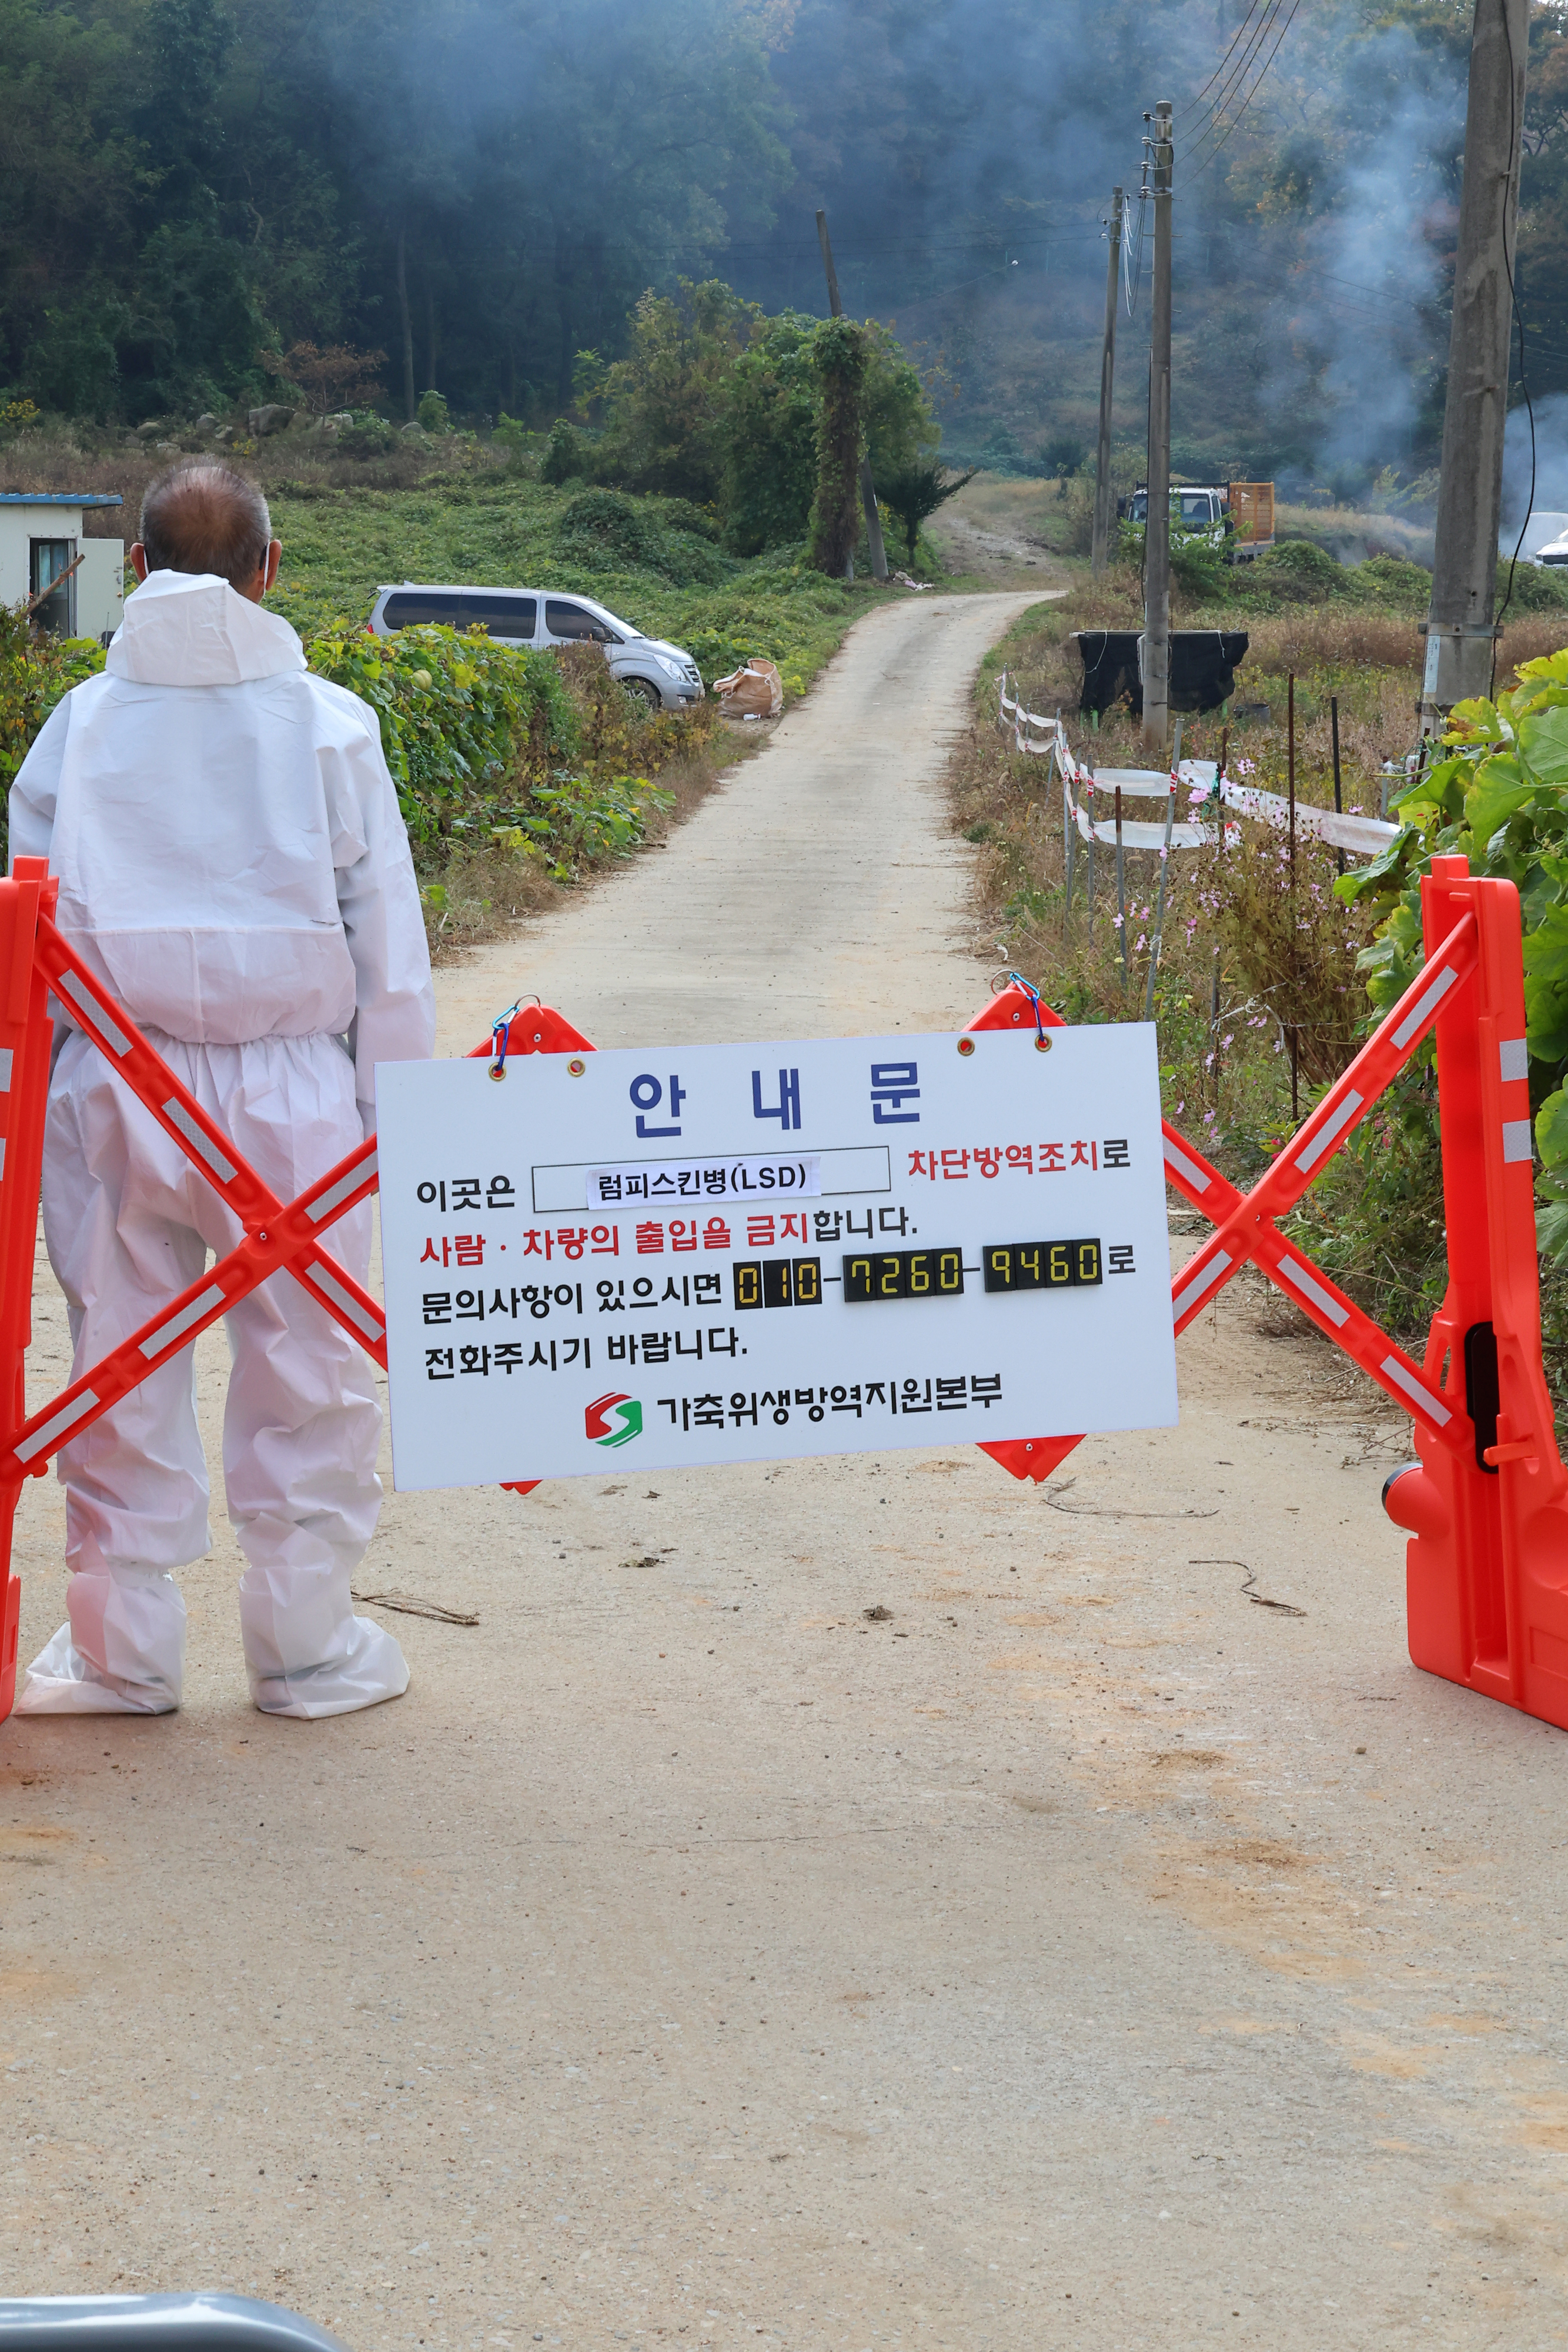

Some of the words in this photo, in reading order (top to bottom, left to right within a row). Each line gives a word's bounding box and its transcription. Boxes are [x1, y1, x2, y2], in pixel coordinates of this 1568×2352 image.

[417, 1175, 515, 1212] 이곳은
[599, 1163, 806, 1201] 럼피스킨병(LSD)
[908, 1139, 1131, 1181] 차단방역조치로
[420, 1234, 486, 1268] 사람
[523, 1225, 619, 1261] 차량의
[636, 1217, 731, 1254] 출입을
[747, 1207, 918, 1247] 금지합니다.
[422, 1282, 583, 1325] 문의사항이
[596, 1273, 722, 1313] 있으시면
[425, 1337, 591, 1381] 전화주시기
[607, 1327, 748, 1365] 바랍니다.
[657, 1373, 1003, 1432] 가축위생방역지원본부
